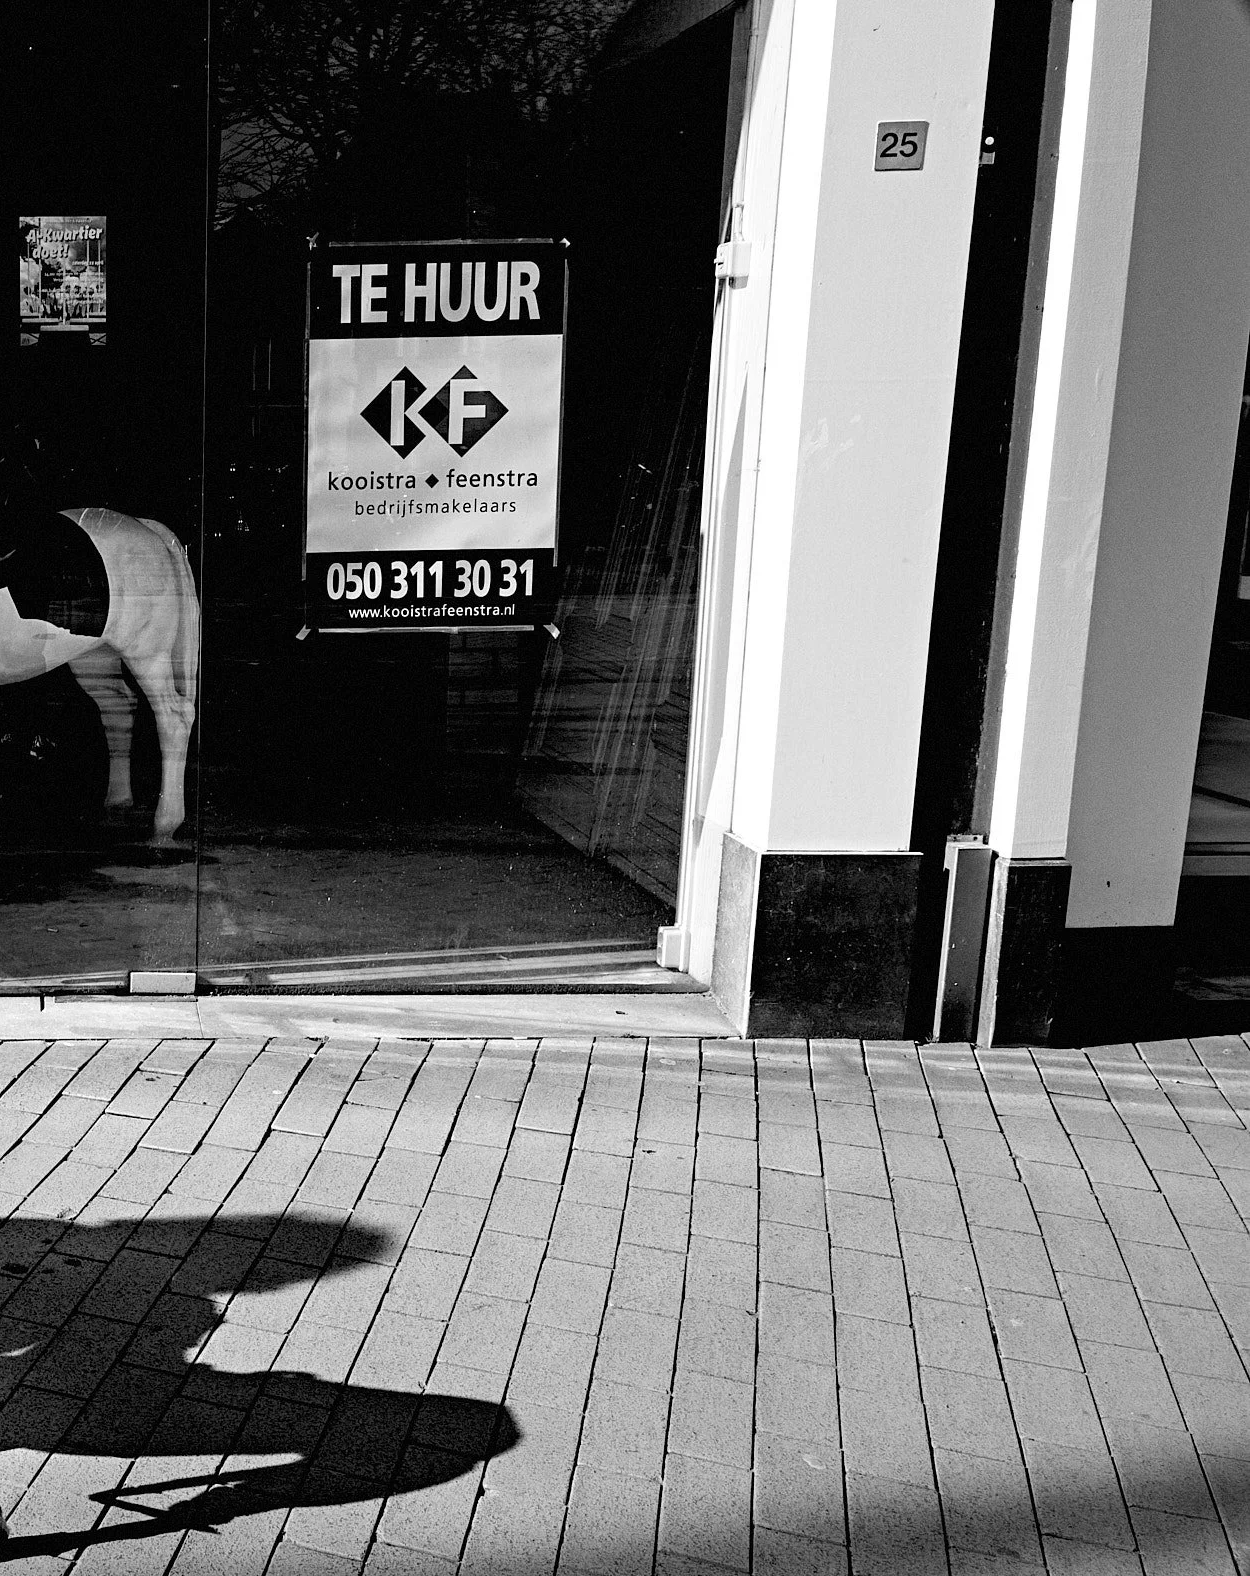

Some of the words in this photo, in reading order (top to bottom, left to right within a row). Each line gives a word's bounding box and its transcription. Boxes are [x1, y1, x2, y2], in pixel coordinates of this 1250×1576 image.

[879, 132, 919, 158] 25
[32, 244, 69, 259] doet!
[332, 263, 389, 324] TE
[403, 260, 541, 323] HUUR
[388, 374, 490, 450] KF
[328, 470, 417, 491] kooistra
[445, 468, 539, 489] feenstra
[354, 498, 517, 518] bedrijfsmakelaars
[326, 561, 383, 600] 050
[390, 560, 444, 599] 311
[453, 559, 492, 598] 30
[498, 558, 534, 598] 31
[348, 603, 516, 619] www.kooistrafeenstra.nl
